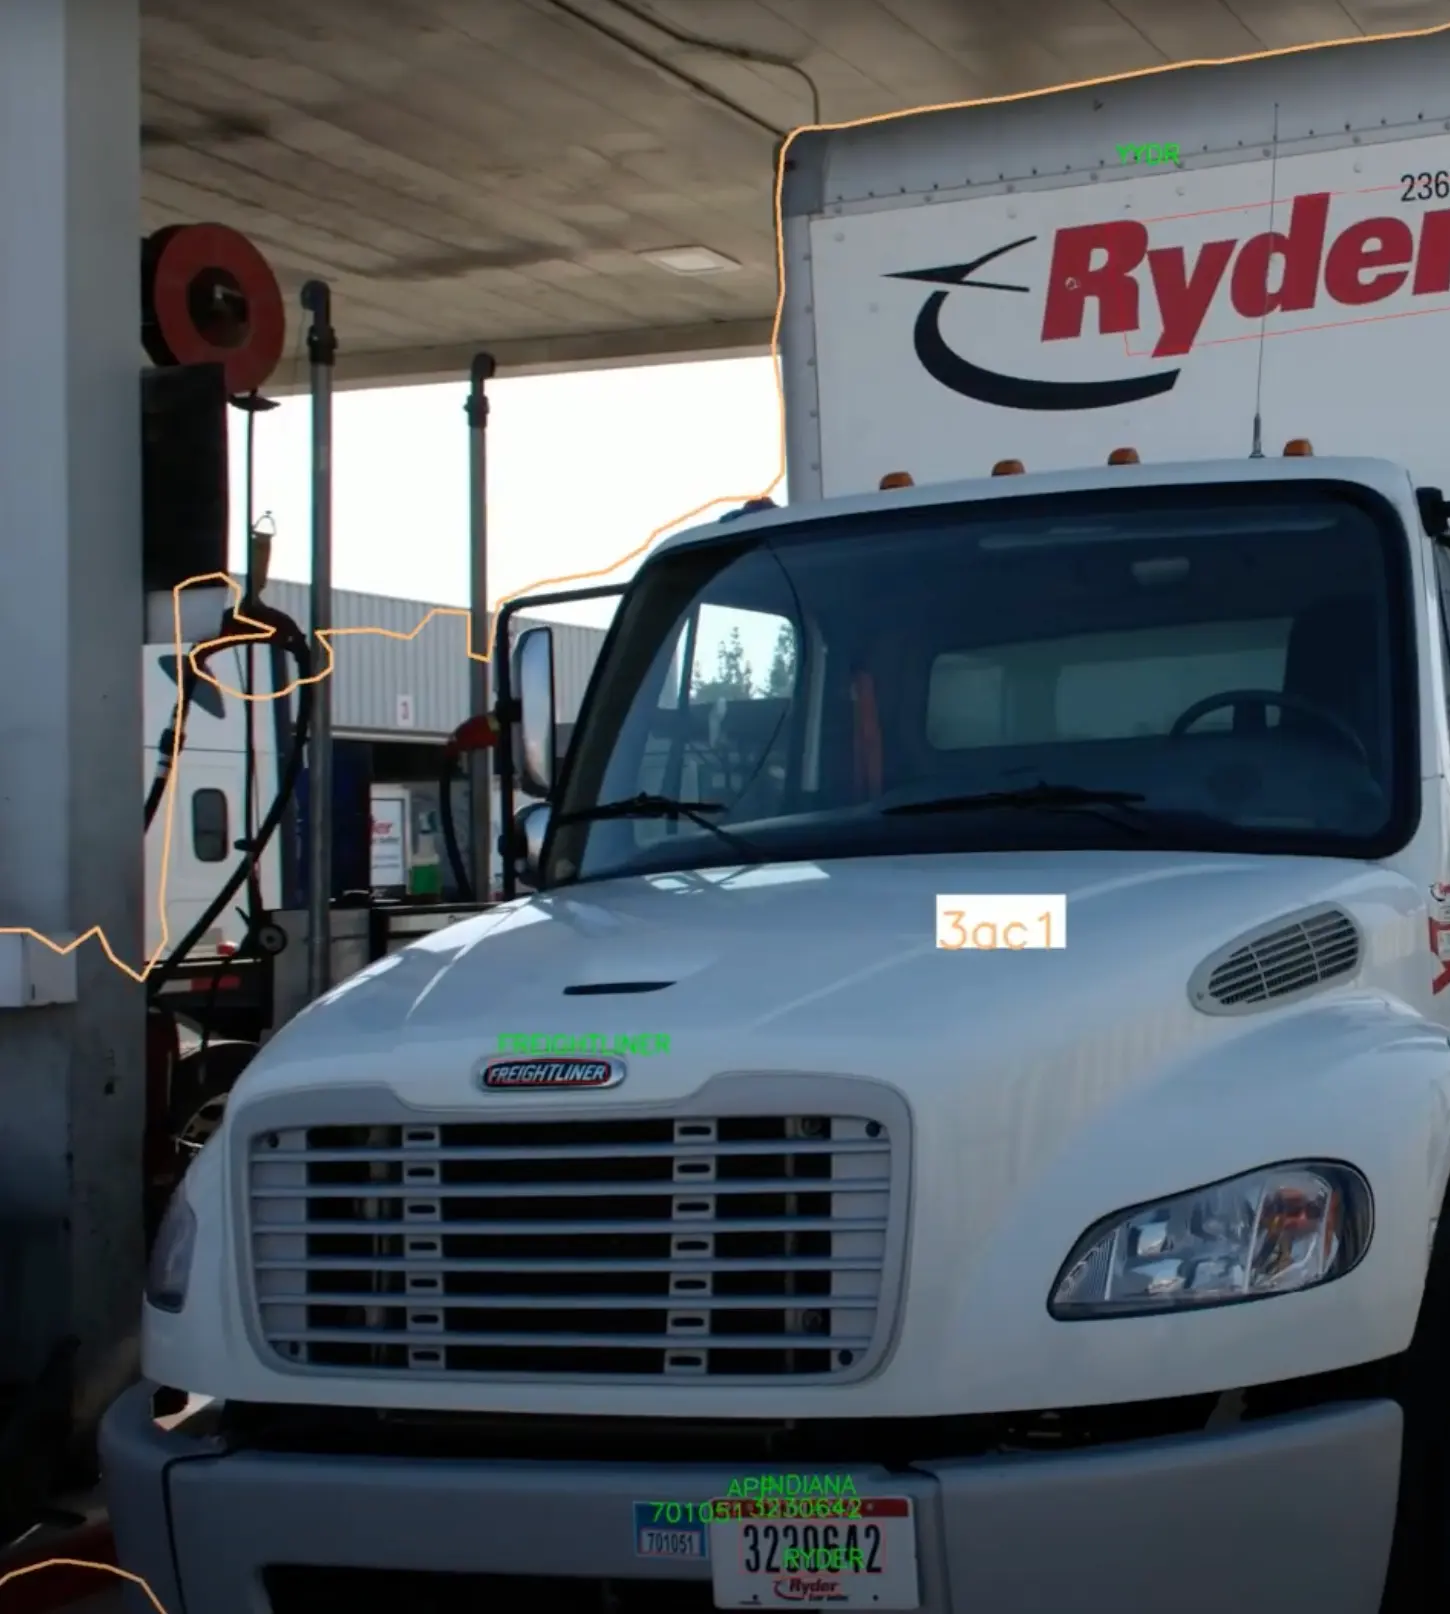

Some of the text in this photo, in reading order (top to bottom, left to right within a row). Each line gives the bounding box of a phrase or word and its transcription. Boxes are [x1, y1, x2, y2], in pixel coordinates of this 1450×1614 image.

[489, 1063, 606, 1083] FREIGHTLINER
[648, 1532, 693, 1555] 701051
[743, 1524, 882, 1573] 3230642
